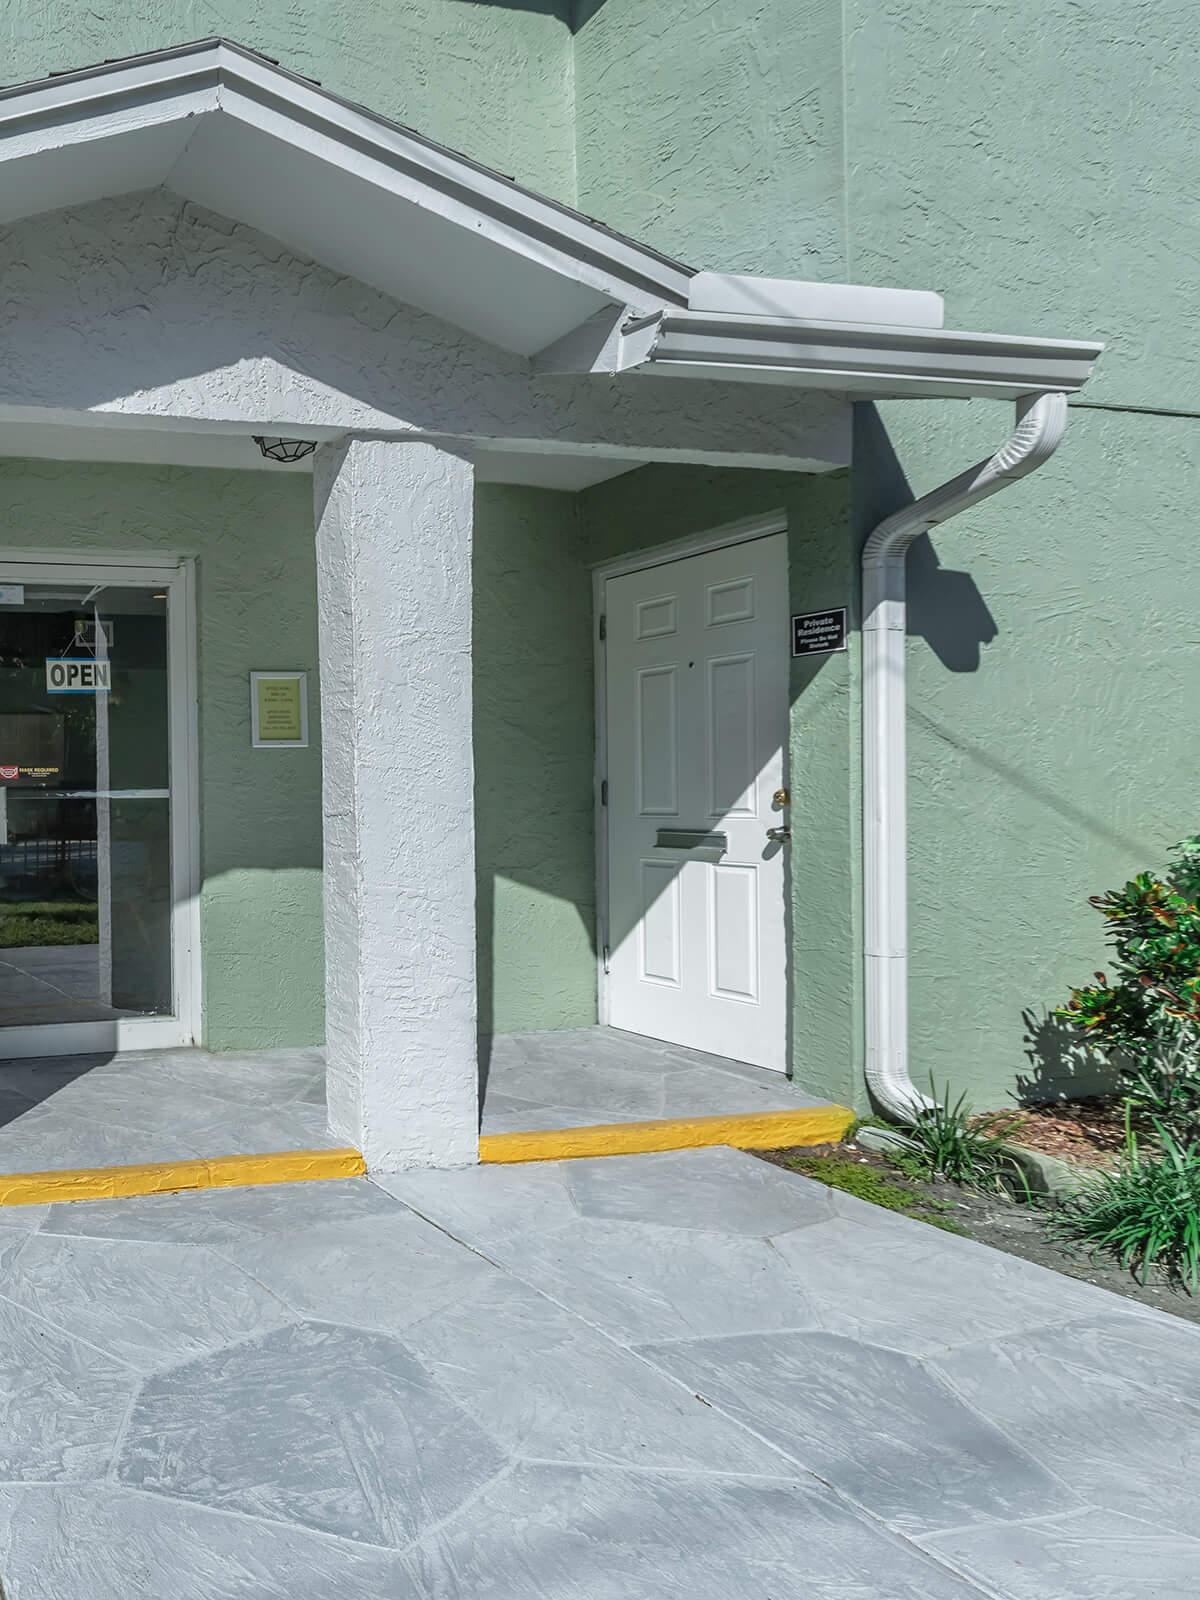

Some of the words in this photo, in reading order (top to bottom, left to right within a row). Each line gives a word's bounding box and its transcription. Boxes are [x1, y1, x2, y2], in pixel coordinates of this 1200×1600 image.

[803, 617, 834, 629] Private
[797, 625, 841, 637] Residence
[51, 664, 108, 687] OPEN
